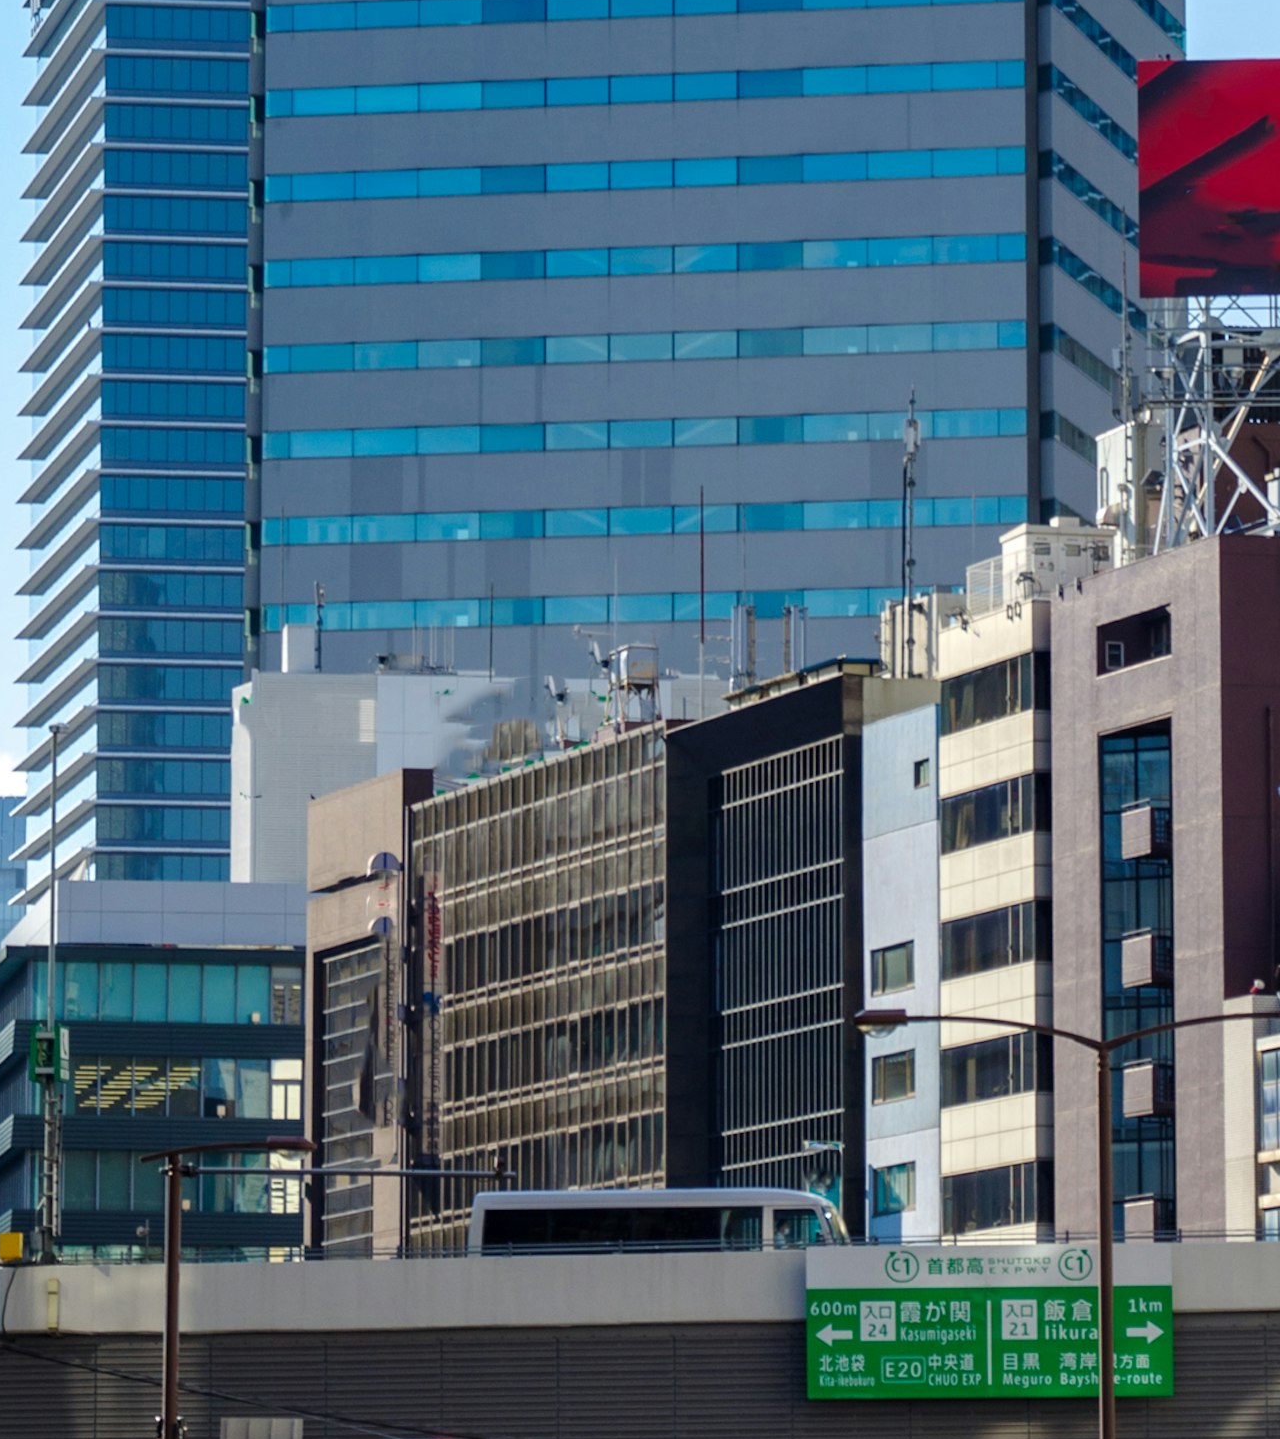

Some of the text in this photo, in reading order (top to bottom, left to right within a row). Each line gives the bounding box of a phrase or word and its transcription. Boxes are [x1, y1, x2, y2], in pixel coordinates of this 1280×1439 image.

[891, 1258, 911, 1276] C1
[926, 1256, 985, 1276] 首都高
[987, 1256, 1052, 1265] SHUTOKO
[1064, 1255, 1084, 1274] C1
[809, 1300, 858, 1317] 600m
[863, 1304, 893, 1321] 入口
[899, 1300, 972, 1324] 霞が関
[1005, 1303, 1034, 1319] 入口
[1043, 1298, 1093, 1322] 飯倉
[1128, 1297, 1163, 1314] 1km
[867, 1323, 889, 1338] 24
[900, 1324, 977, 1346] Kasumigaseki
[1008, 1322, 1031, 1337] 21
[1044, 1324, 1099, 1341] Iikura
[818, 1353, 866, 1373] 北池袋
[884, 1361, 922, 1378] E20
[927, 1352, 975, 1371] 中央道
[1002, 1352, 1041, 1372] 目黒
[927, 1372, 983, 1387] CHUO EXP
[1002, 1372, 1163, 1389] Meguro Bayshe-route
